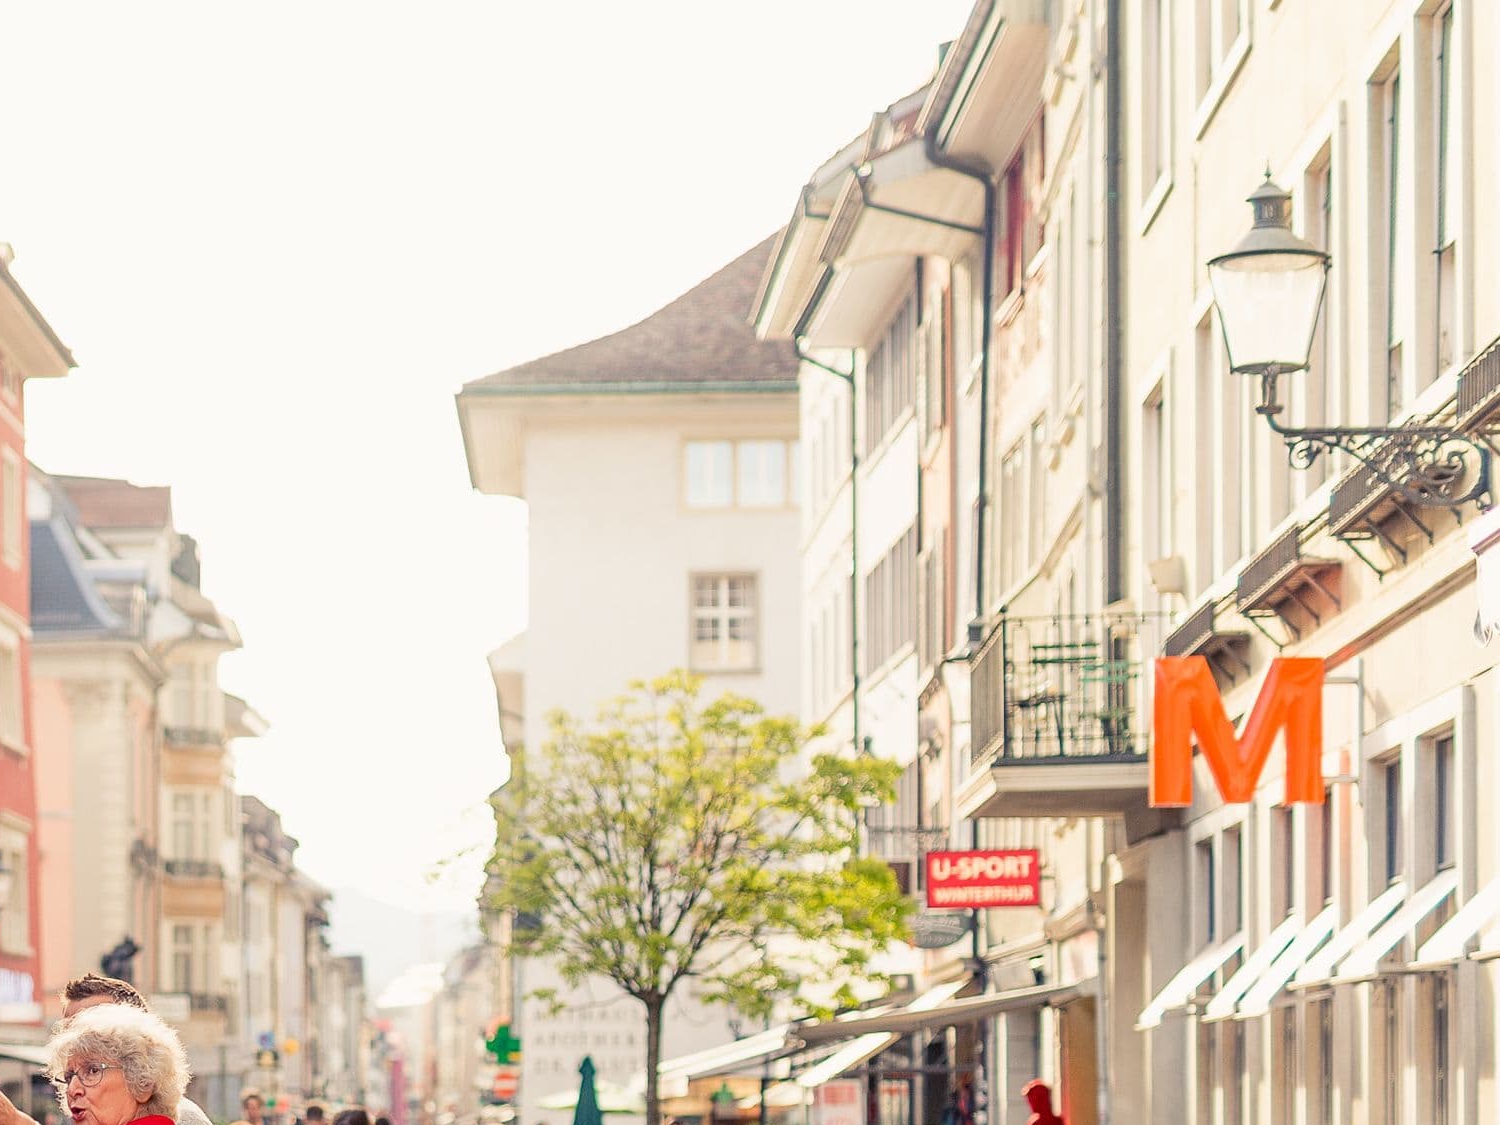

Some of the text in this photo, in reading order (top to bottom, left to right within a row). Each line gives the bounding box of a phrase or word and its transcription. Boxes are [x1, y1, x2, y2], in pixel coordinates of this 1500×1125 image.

[1149, 656, 1326, 808] M
[930, 855, 1034, 881] U-SPORT
[932, 885, 1035, 905] WINTERTHUR
